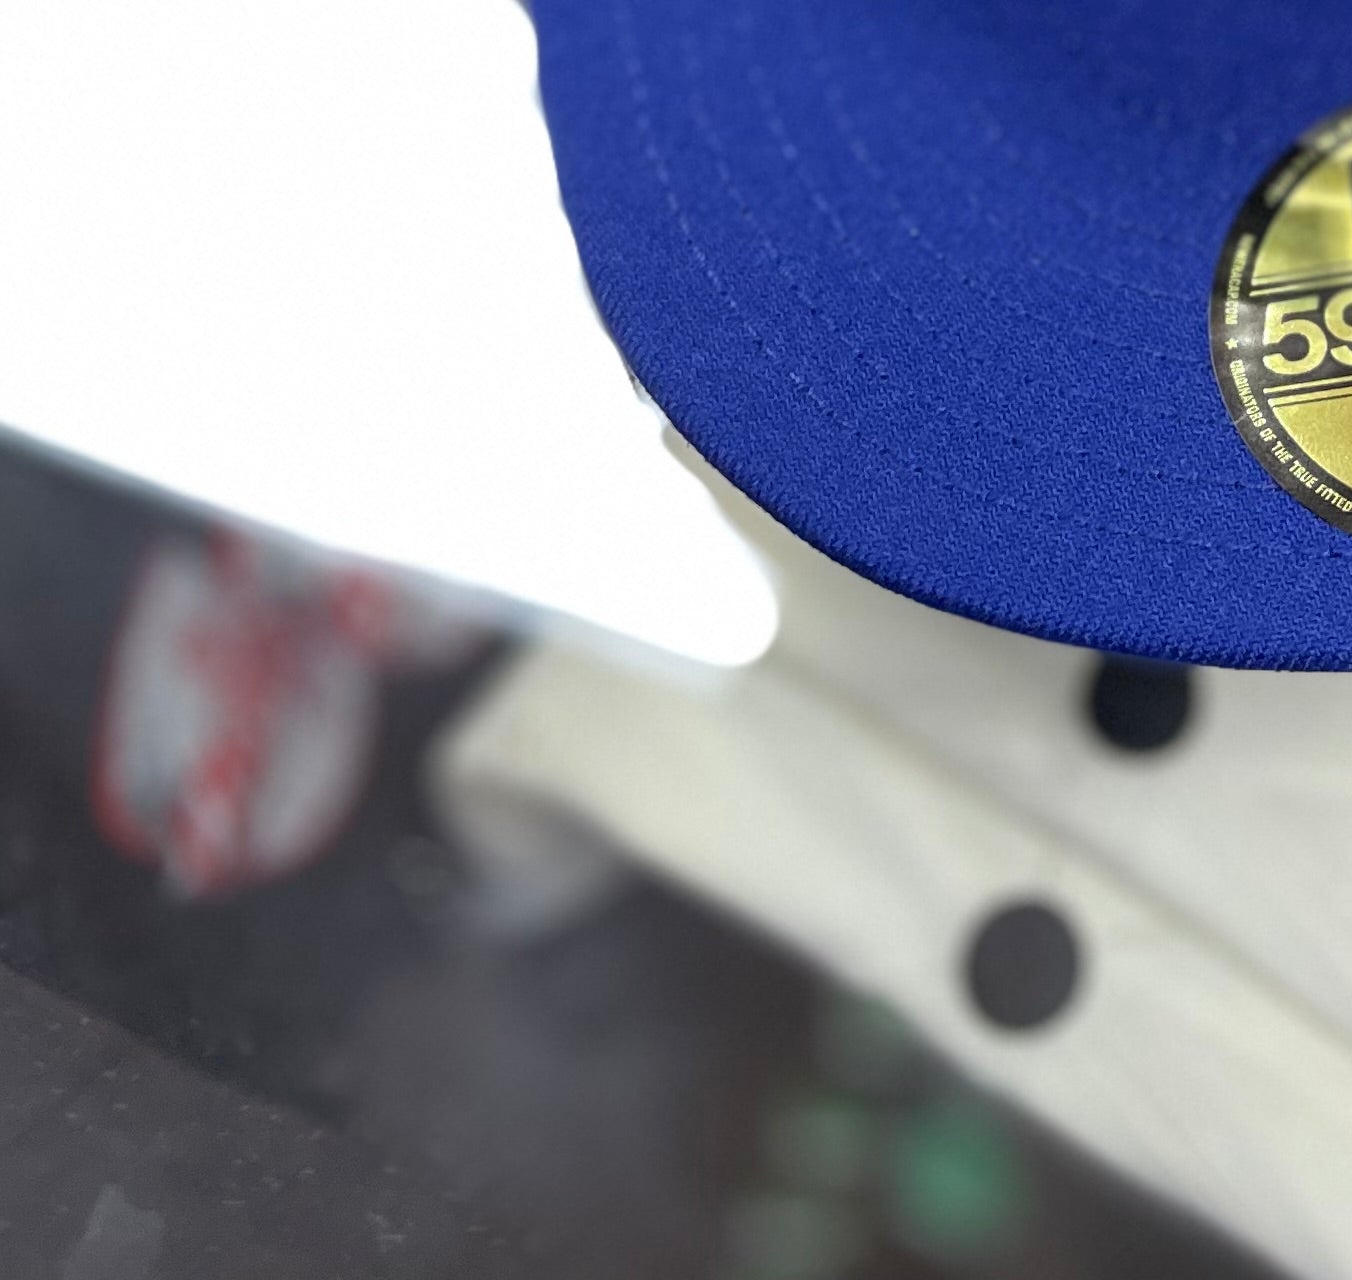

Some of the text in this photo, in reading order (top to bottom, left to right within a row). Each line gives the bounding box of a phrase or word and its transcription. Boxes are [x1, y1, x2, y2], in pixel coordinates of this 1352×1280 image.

[1259, 427, 1277, 442] OF
[1271, 441, 1294, 464] THE
[1289, 460, 1319, 489] TRUE
